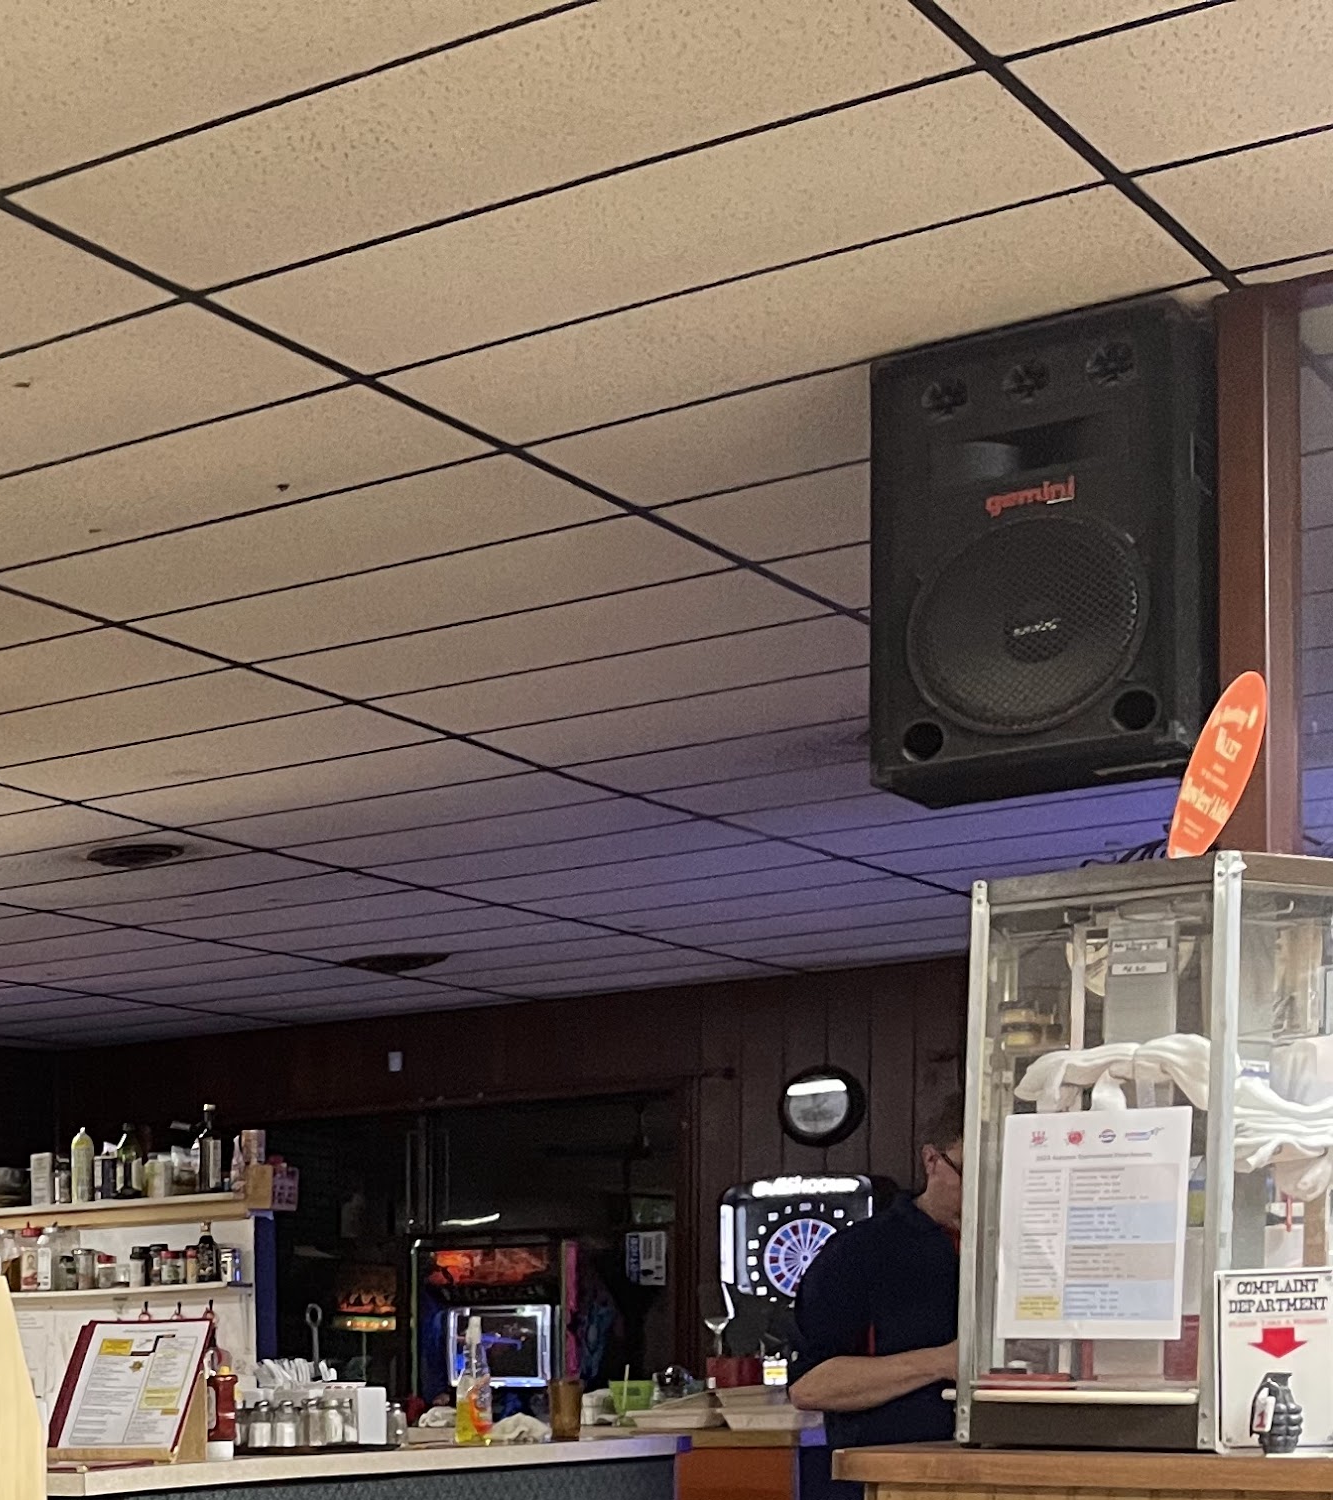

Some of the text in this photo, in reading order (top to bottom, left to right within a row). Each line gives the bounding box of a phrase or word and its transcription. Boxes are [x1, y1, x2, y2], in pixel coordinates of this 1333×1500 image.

[985, 475, 1075, 518] gemini
[1237, 1278, 1319, 1295] COMPLAINT
[1228, 1296, 1329, 1315] DEPARTMENT
[1255, 1413, 1267, 1429] 1
